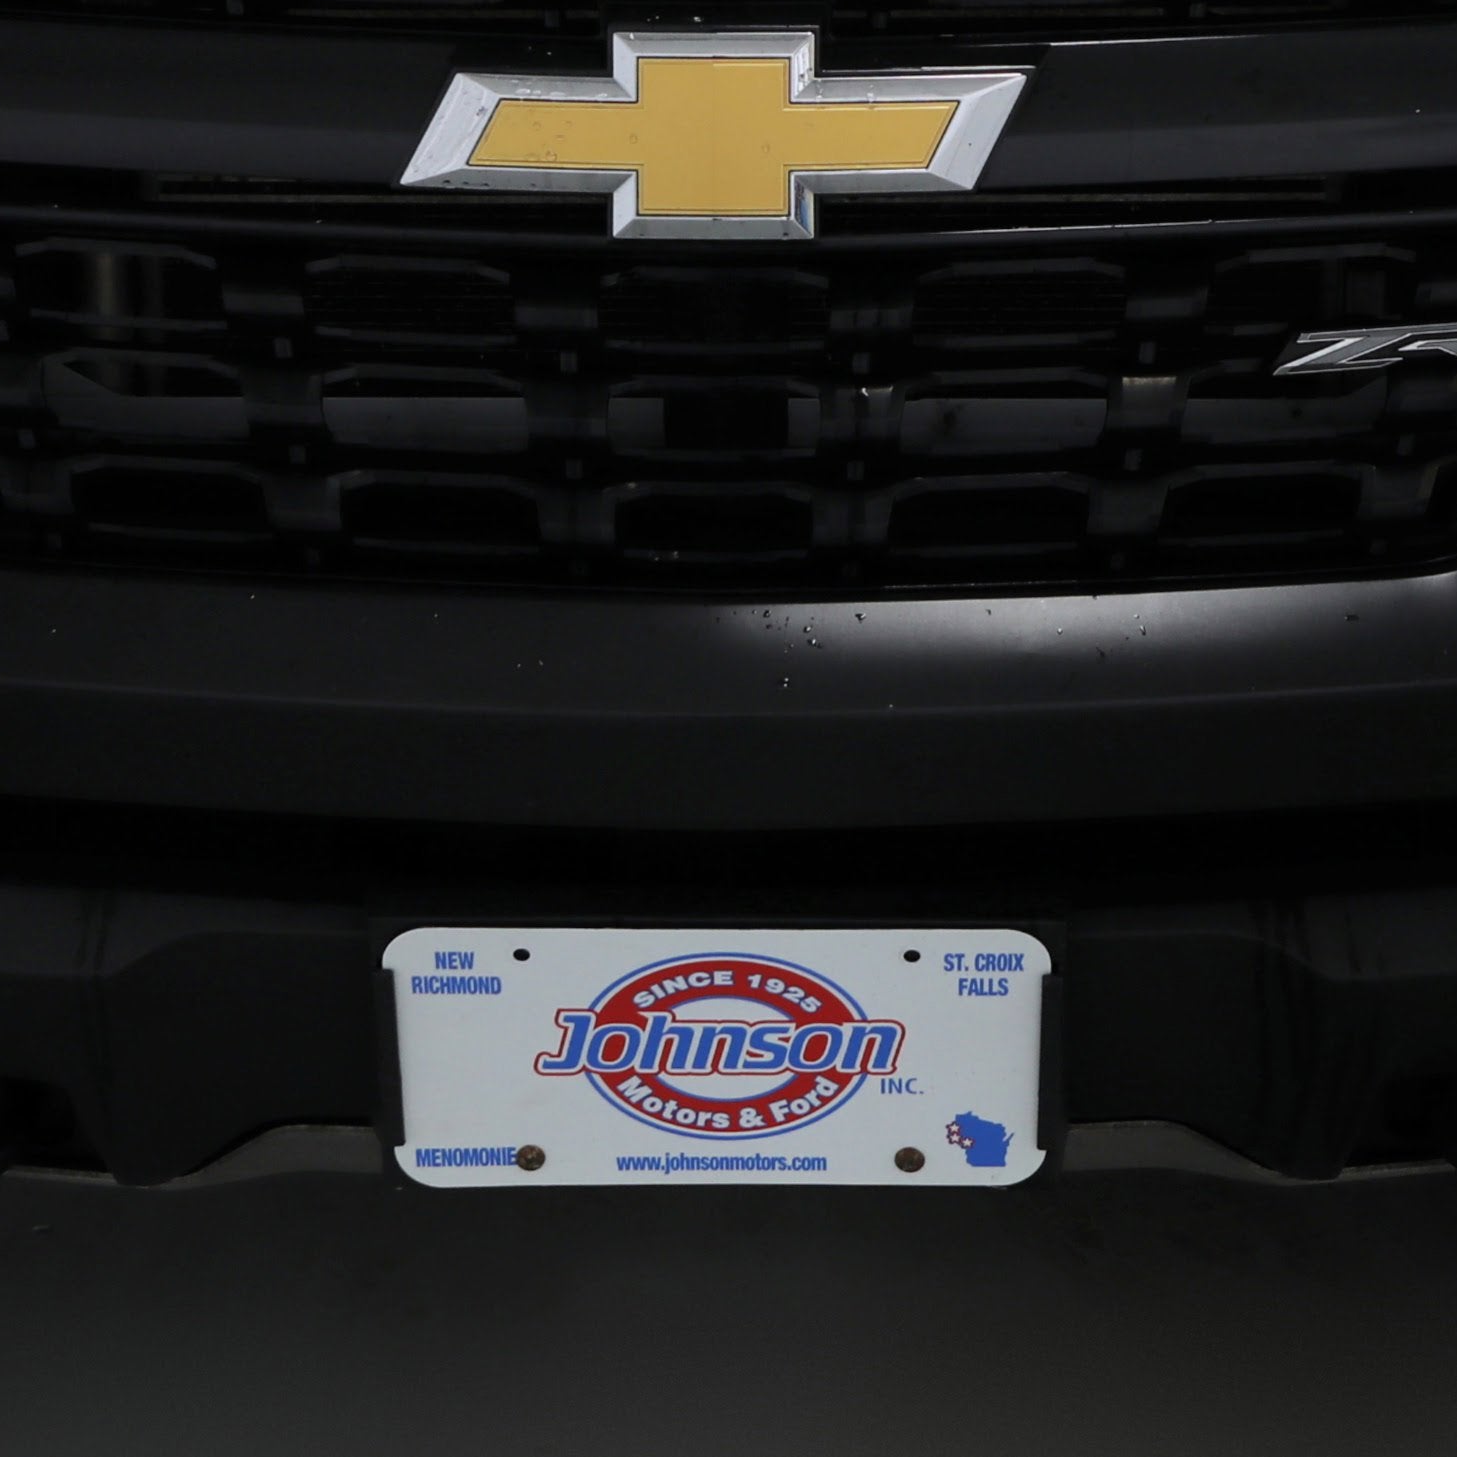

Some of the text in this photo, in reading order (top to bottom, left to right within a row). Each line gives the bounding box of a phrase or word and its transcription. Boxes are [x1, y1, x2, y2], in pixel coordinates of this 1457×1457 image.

[434, 952, 474, 970] NEW
[944, 953, 1024, 973] ST. CROIX
[411, 975, 501, 995] RICHMOND
[633, 971, 823, 1013] SINCE 1925
[959, 978, 1009, 997] FALLS
[536, 1009, 905, 1075] Johnson
[880, 1077, 925, 1095] INC.
[617, 1076, 840, 1129] Motors & Ford
[415, 1147, 518, 1168] MENOMONIE
[616, 1152, 827, 1174] www.johnsonmotors.com
